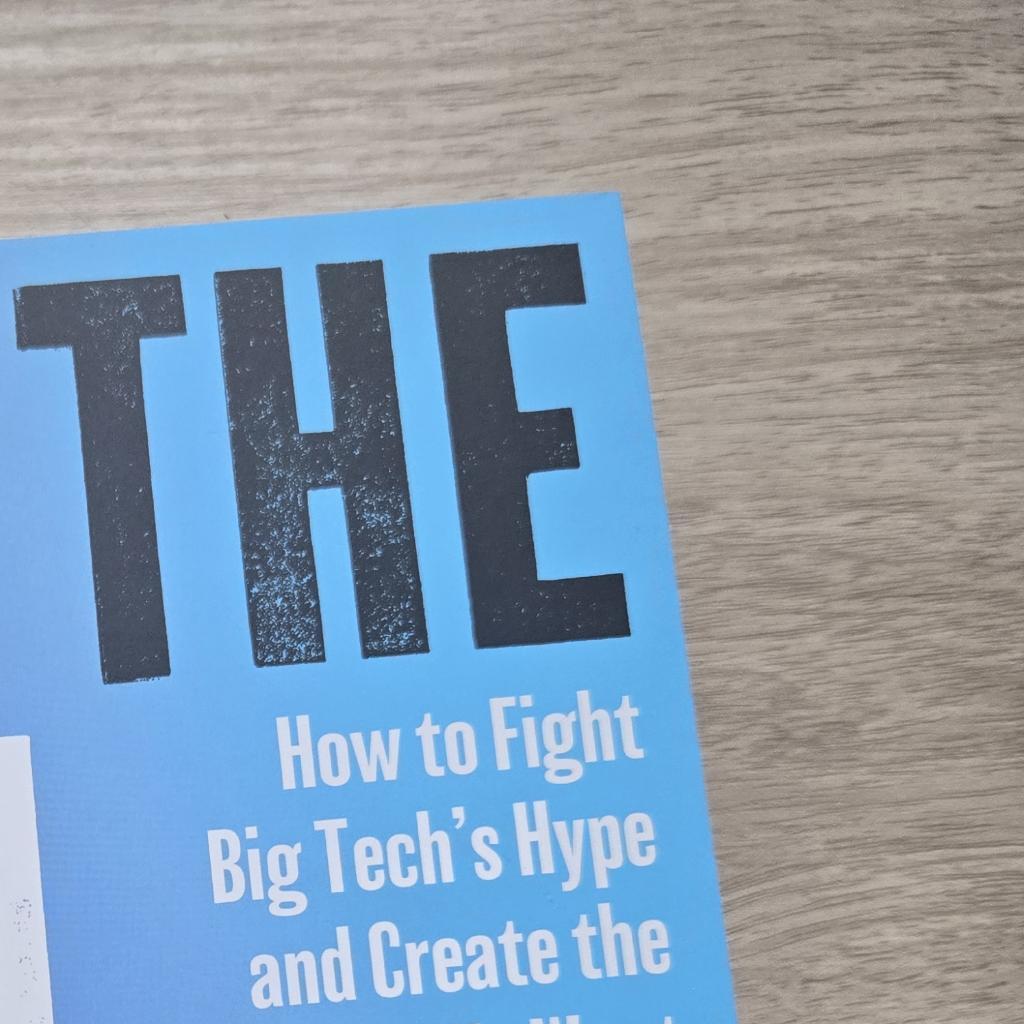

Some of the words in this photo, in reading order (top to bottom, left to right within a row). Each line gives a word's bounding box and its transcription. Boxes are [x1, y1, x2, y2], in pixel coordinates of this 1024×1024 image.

[12, 242, 631, 685] THE
[276, 713, 401, 791] How
[415, 712, 477, 778] to
[489, 689, 645, 785] Fight
[207, 826, 309, 917] Big
[314, 805, 504, 895] Tech’s
[512, 799, 658, 892] Hype
[248, 925, 357, 1011] and
[368, 920, 560, 1000] Create
[570, 901, 672, 981] the
